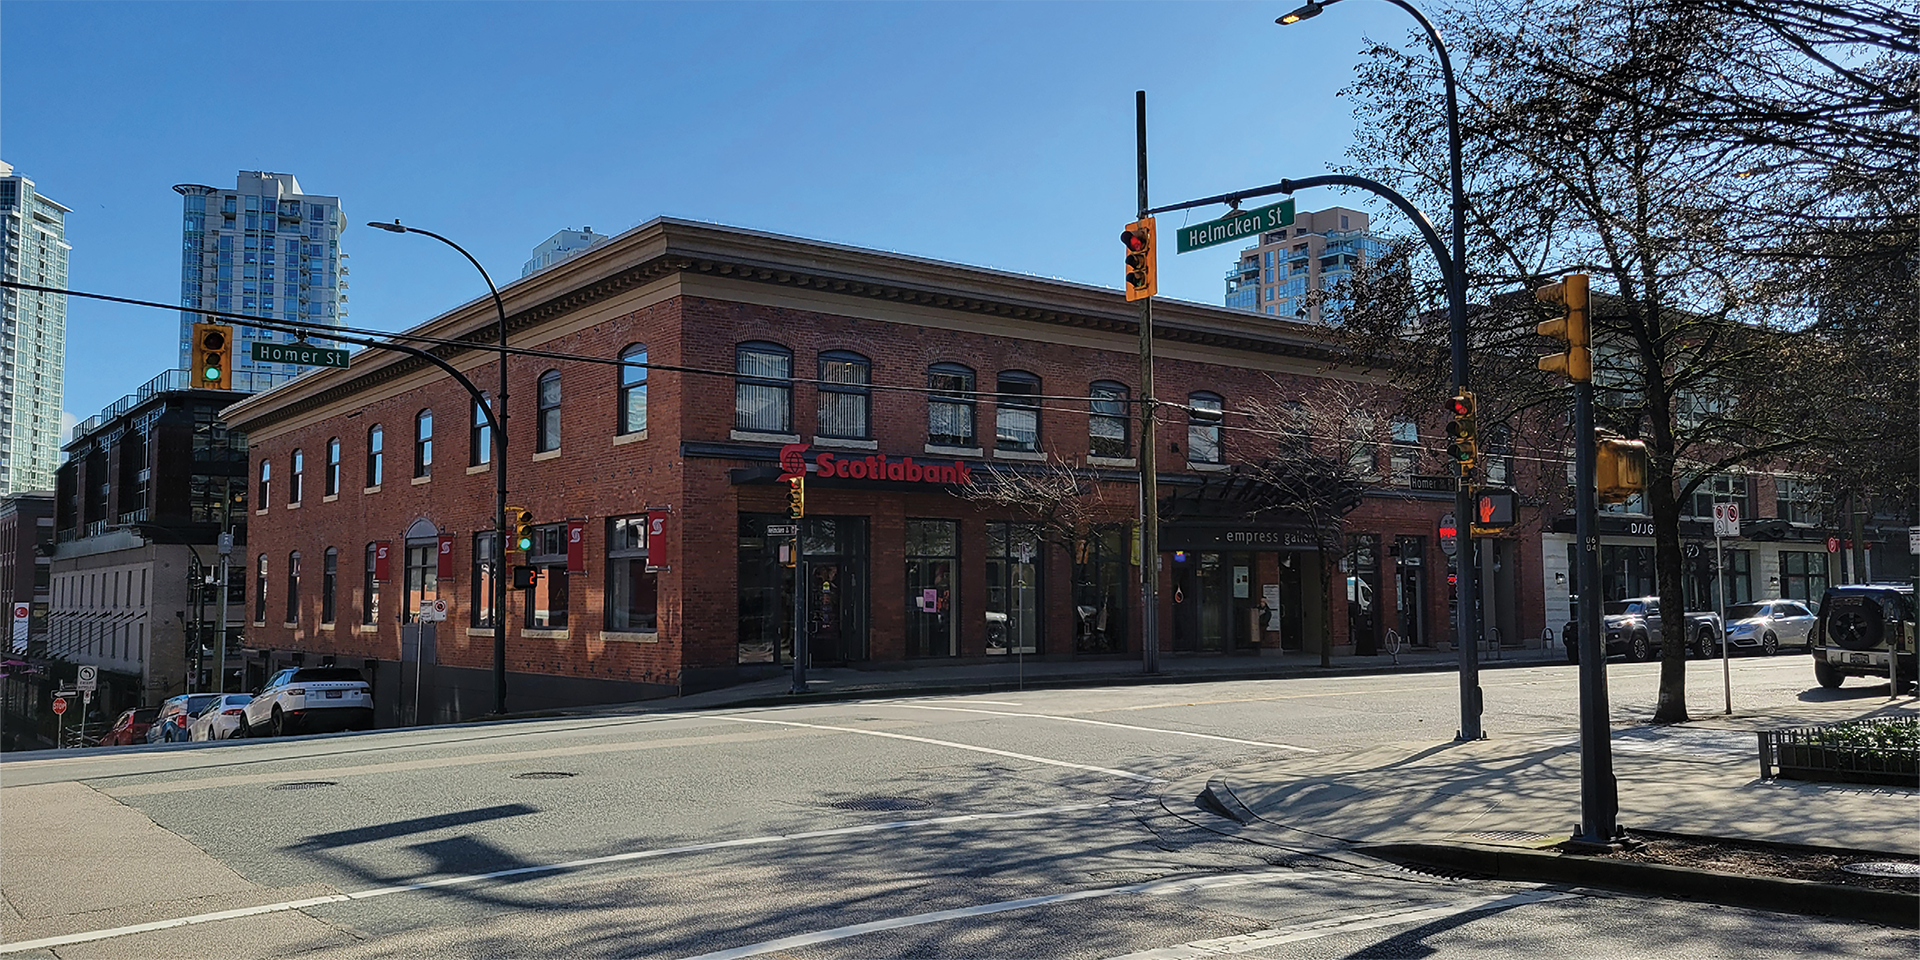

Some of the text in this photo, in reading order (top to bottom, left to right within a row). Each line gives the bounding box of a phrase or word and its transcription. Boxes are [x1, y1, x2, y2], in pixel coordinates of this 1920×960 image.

[1189, 206, 1282, 247] Helmcken St
[260, 345, 341, 366] Homer St
[816, 453, 972, 485] Scotiabank
[1411, 477, 1437, 489] Homer
[1226, 531, 1279, 545] empress
[529, 570, 536, 585] 2
[53, 702, 67, 710] STOP
